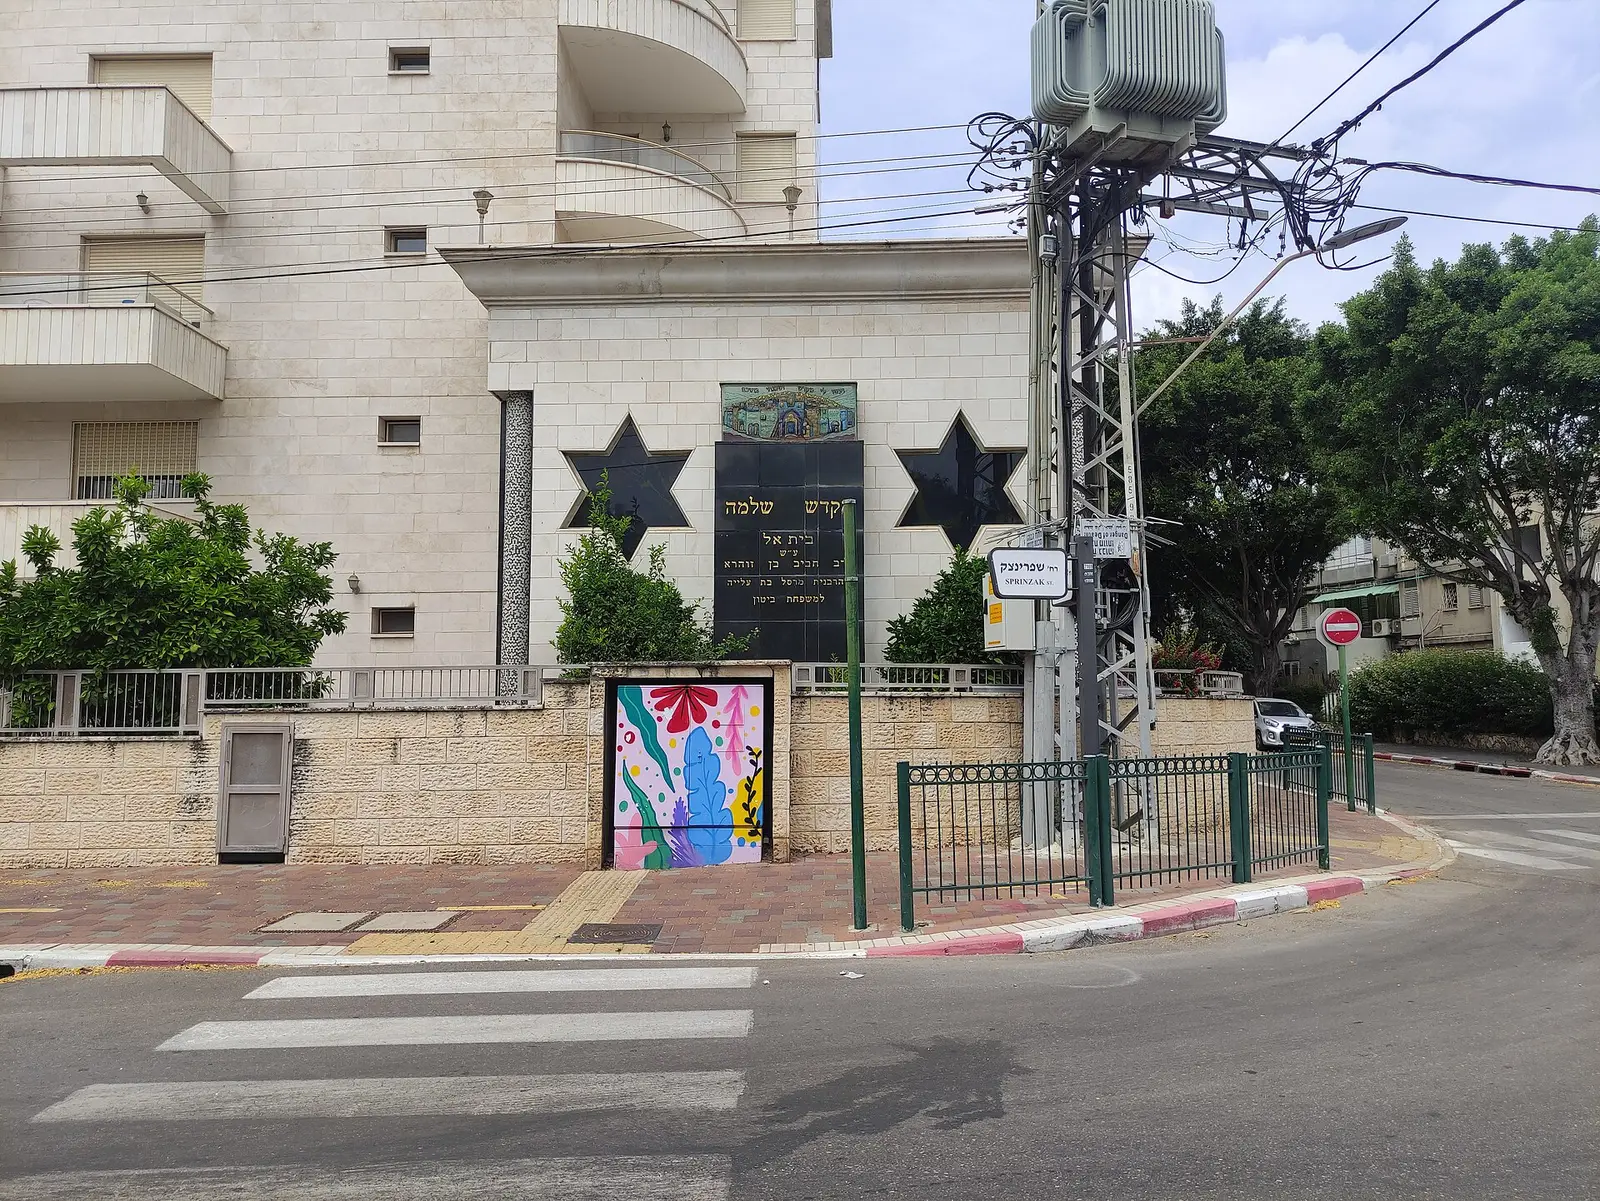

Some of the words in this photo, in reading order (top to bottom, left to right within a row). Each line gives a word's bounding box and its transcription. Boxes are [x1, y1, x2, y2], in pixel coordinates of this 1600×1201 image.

[725, 495, 774, 515] שלמה
[804, 499, 844, 519] קדש
[762, 532, 782, 545] אל
[787, 534, 814, 545] בית
[724, 560, 754, 568] זוהרא
[767, 560, 779, 570] בן
[793, 560, 819, 568] חביב
[1000, 562, 1045, 573] שפרינצק
[760, 578, 772, 586] בת
[781, 577, 804, 586] מרסל
[752, 595, 775, 605] ביטון
[786, 593, 825, 603] למשפחת
